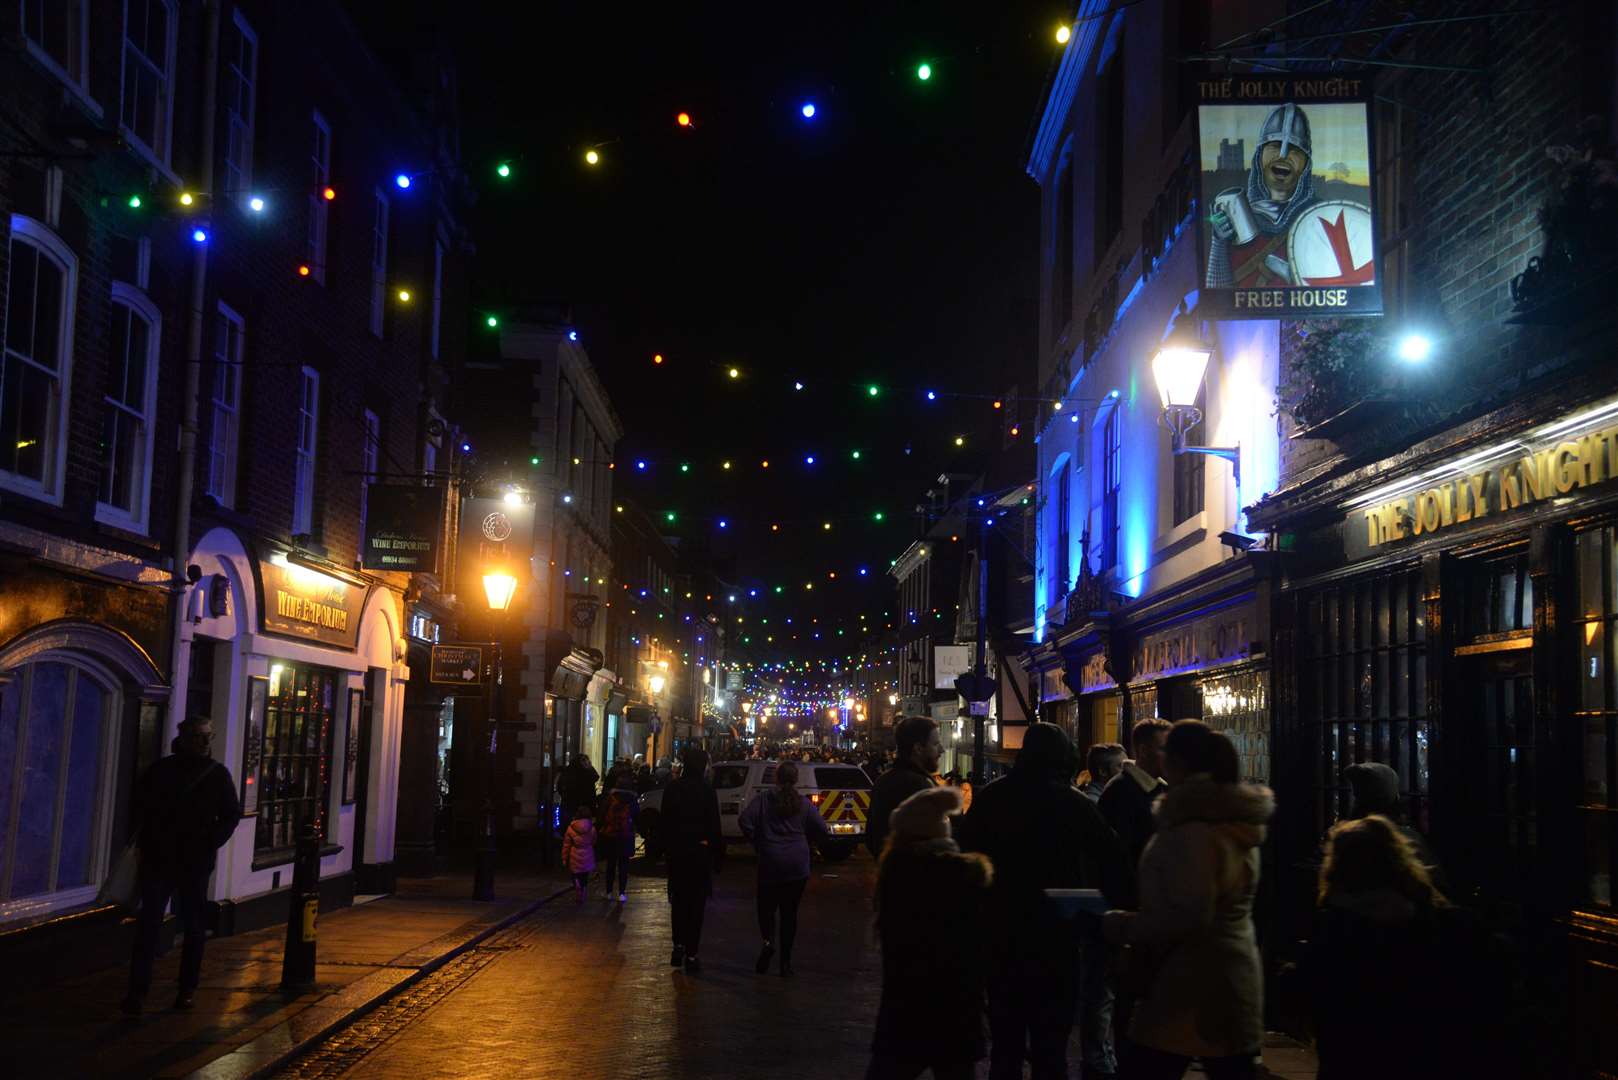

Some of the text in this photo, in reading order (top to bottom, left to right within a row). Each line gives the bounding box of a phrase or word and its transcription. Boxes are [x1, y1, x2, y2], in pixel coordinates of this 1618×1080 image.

[1199, 79, 1361, 98] THE JOLLY KNIGHT
[1234, 289, 1347, 308] FREE HOUSE
[1364, 499, 1408, 547] THE
[1413, 471, 1490, 536] JOLLY
[372, 538, 431, 552] WINE EMPORIUM
[278, 590, 302, 618] WINE
[303, 598, 348, 632] EMPORIUM
